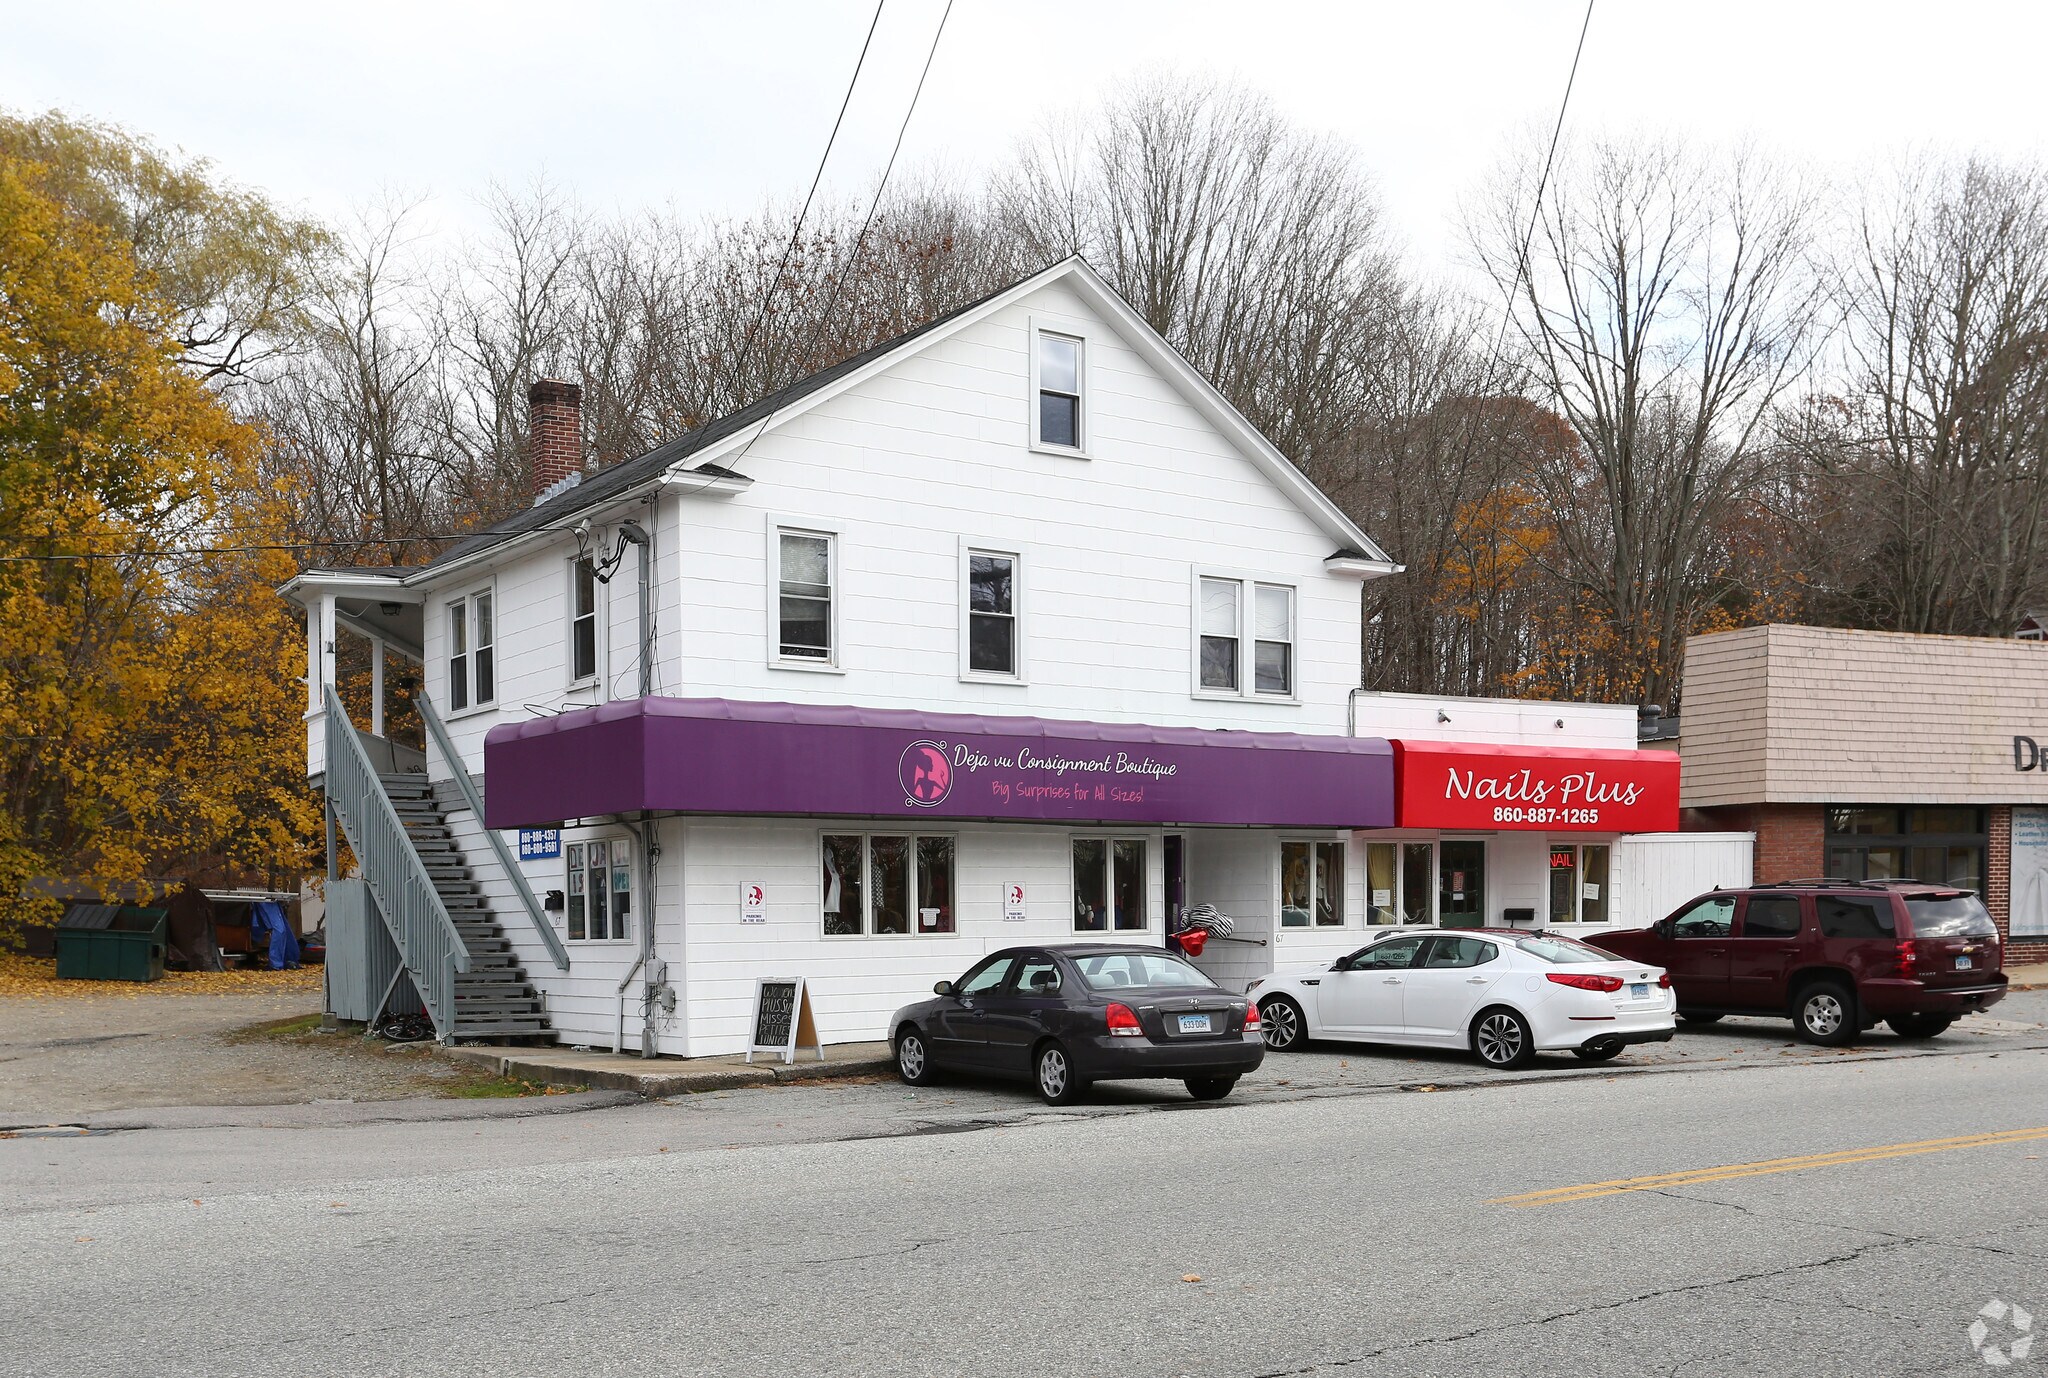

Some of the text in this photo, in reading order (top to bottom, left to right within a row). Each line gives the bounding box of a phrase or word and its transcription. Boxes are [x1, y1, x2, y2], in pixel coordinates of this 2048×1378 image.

[954, 744, 1177, 780] Deja vu Consignment Boutique
[992, 781, 1144, 804] Big Surprises for All Sizes!
[1444, 767, 1645, 806] Nails Plus
[1493, 806, 1599, 825] 860-887-1265
[1275, 934, 1284, 943] 67
